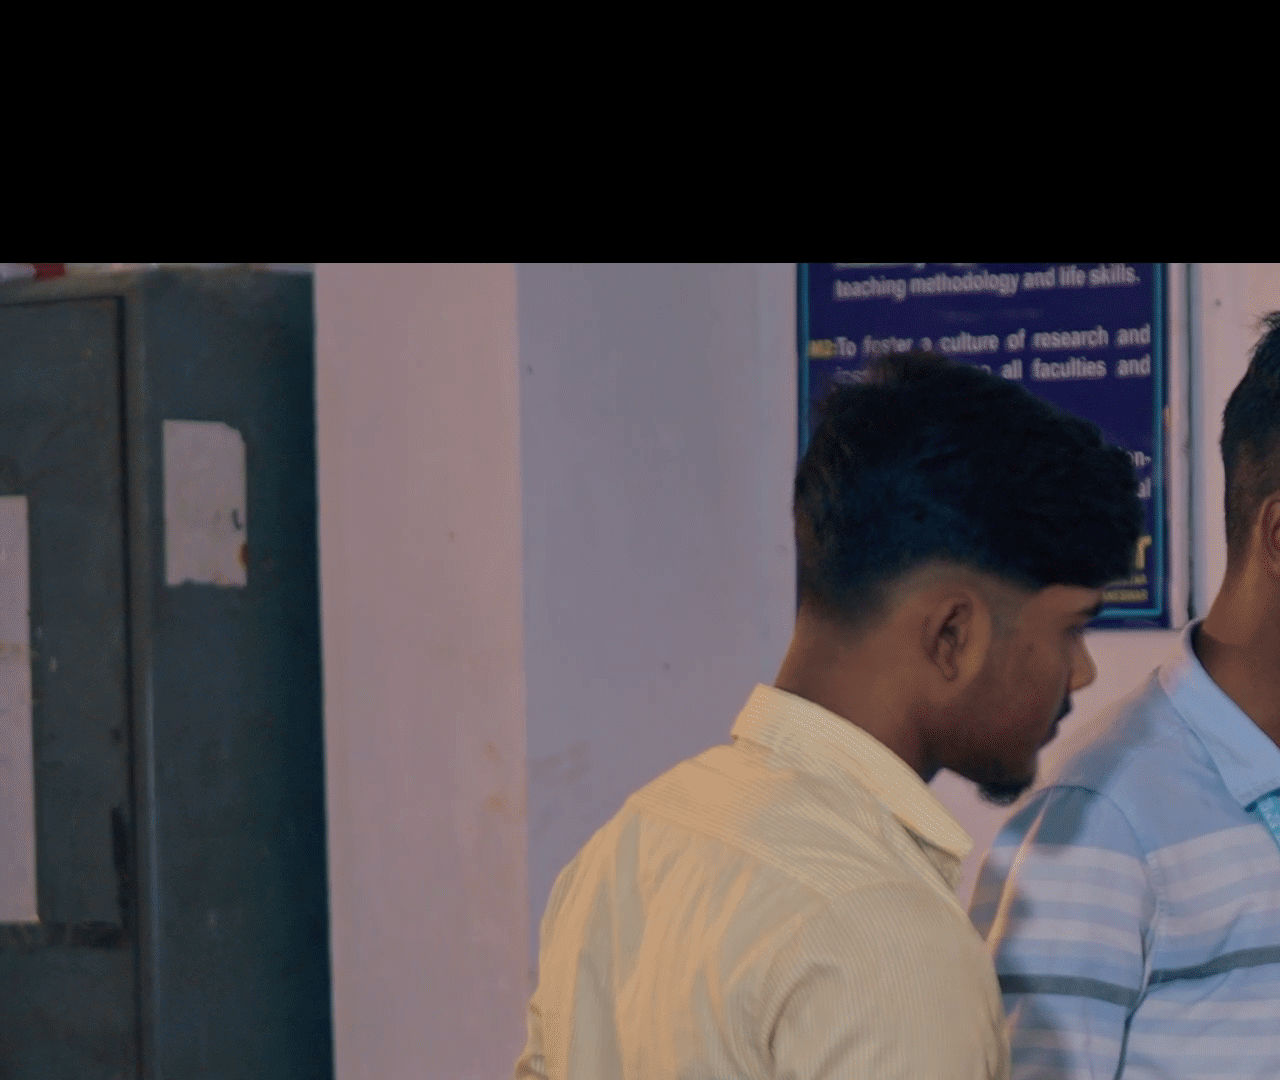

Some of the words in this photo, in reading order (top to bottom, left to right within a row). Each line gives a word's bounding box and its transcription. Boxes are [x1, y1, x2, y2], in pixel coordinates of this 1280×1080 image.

[835, 275, 906, 300] teaching
[909, 269, 1020, 295] methodology
[1023, 267, 1056, 289] and
[1059, 265, 1088, 287] life
[1090, 263, 1141, 287] skills.
[837, 337, 857, 357] To
[940, 332, 999, 353] culture
[1007, 329, 1025, 350] of
[1033, 326, 1108, 348] research
[1117, 324, 1150, 345] and
[1001, 360, 1022, 379] all
[1032, 357, 1106, 379] faculties
[1117, 355, 1150, 376] and
